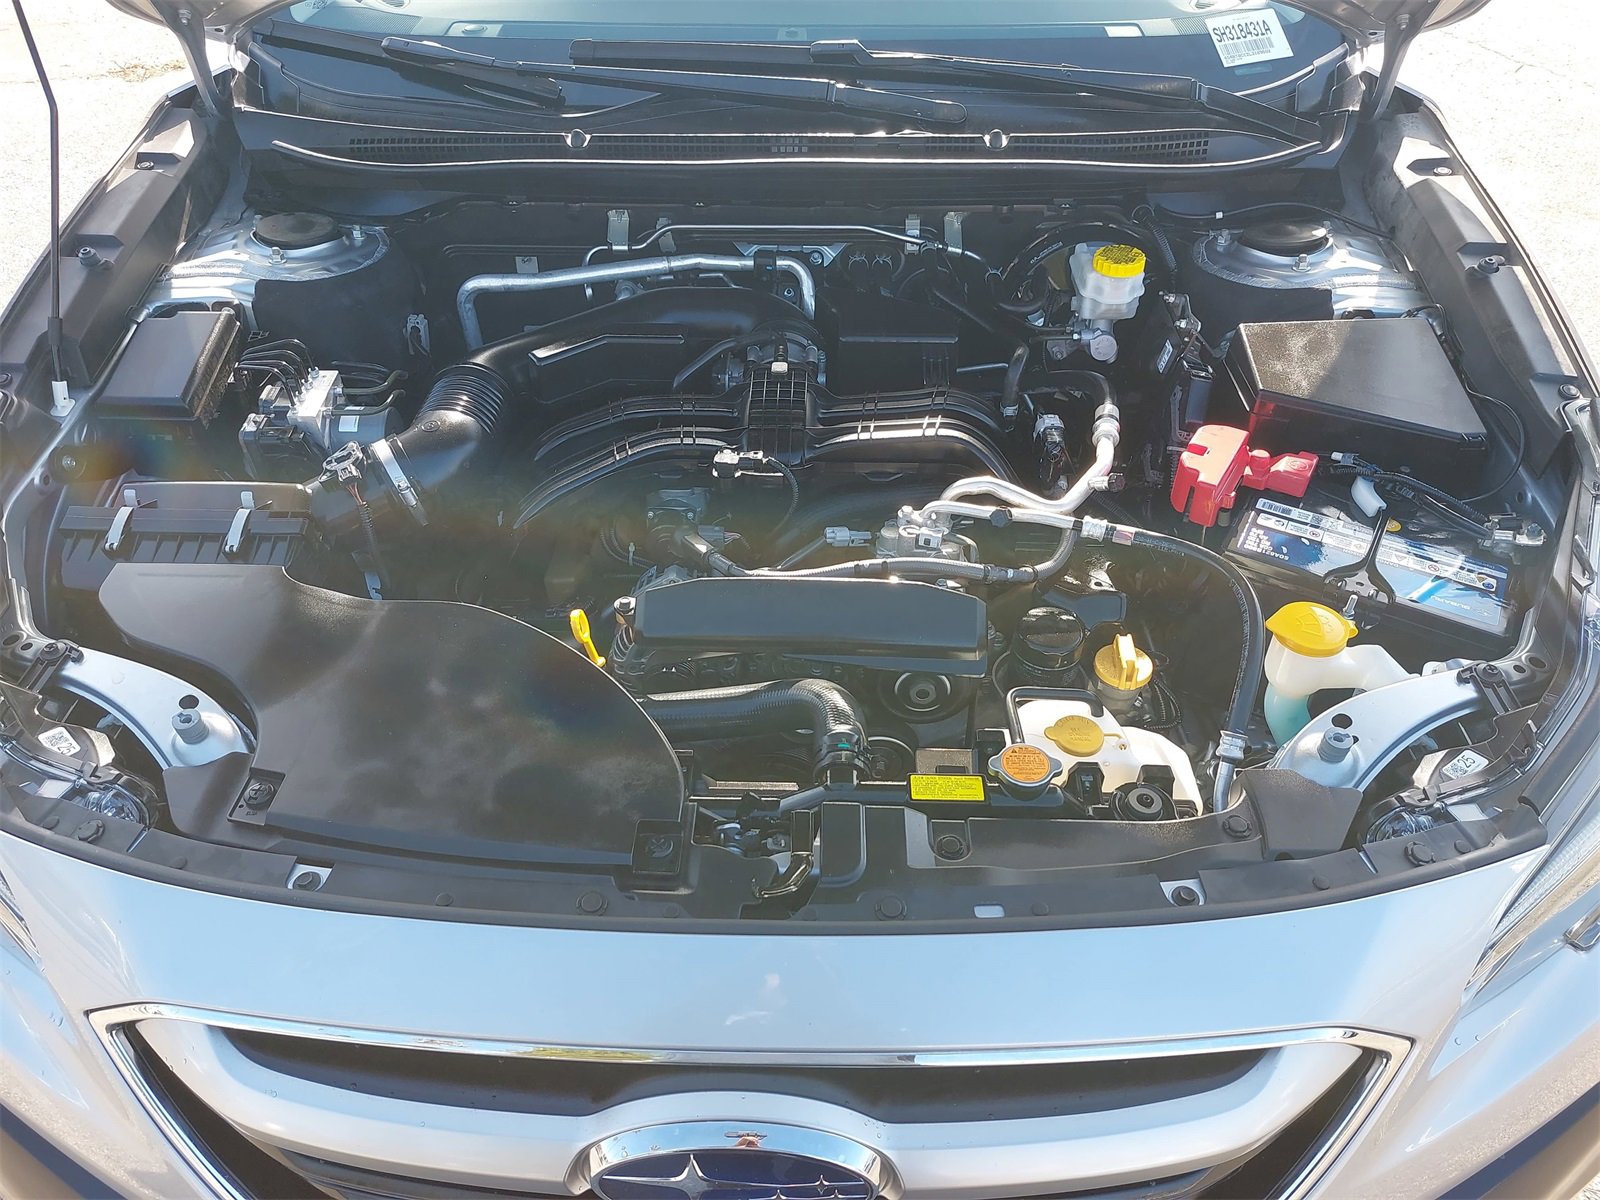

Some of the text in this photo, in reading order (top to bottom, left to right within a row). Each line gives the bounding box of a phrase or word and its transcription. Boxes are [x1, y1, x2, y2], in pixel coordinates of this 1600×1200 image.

[1212, 19, 1273, 43] SH318431A
[1430, 595, 1471, 610] SUBARU
[57, 742, 76, 755] 25
[1457, 755, 1476, 769] 25
